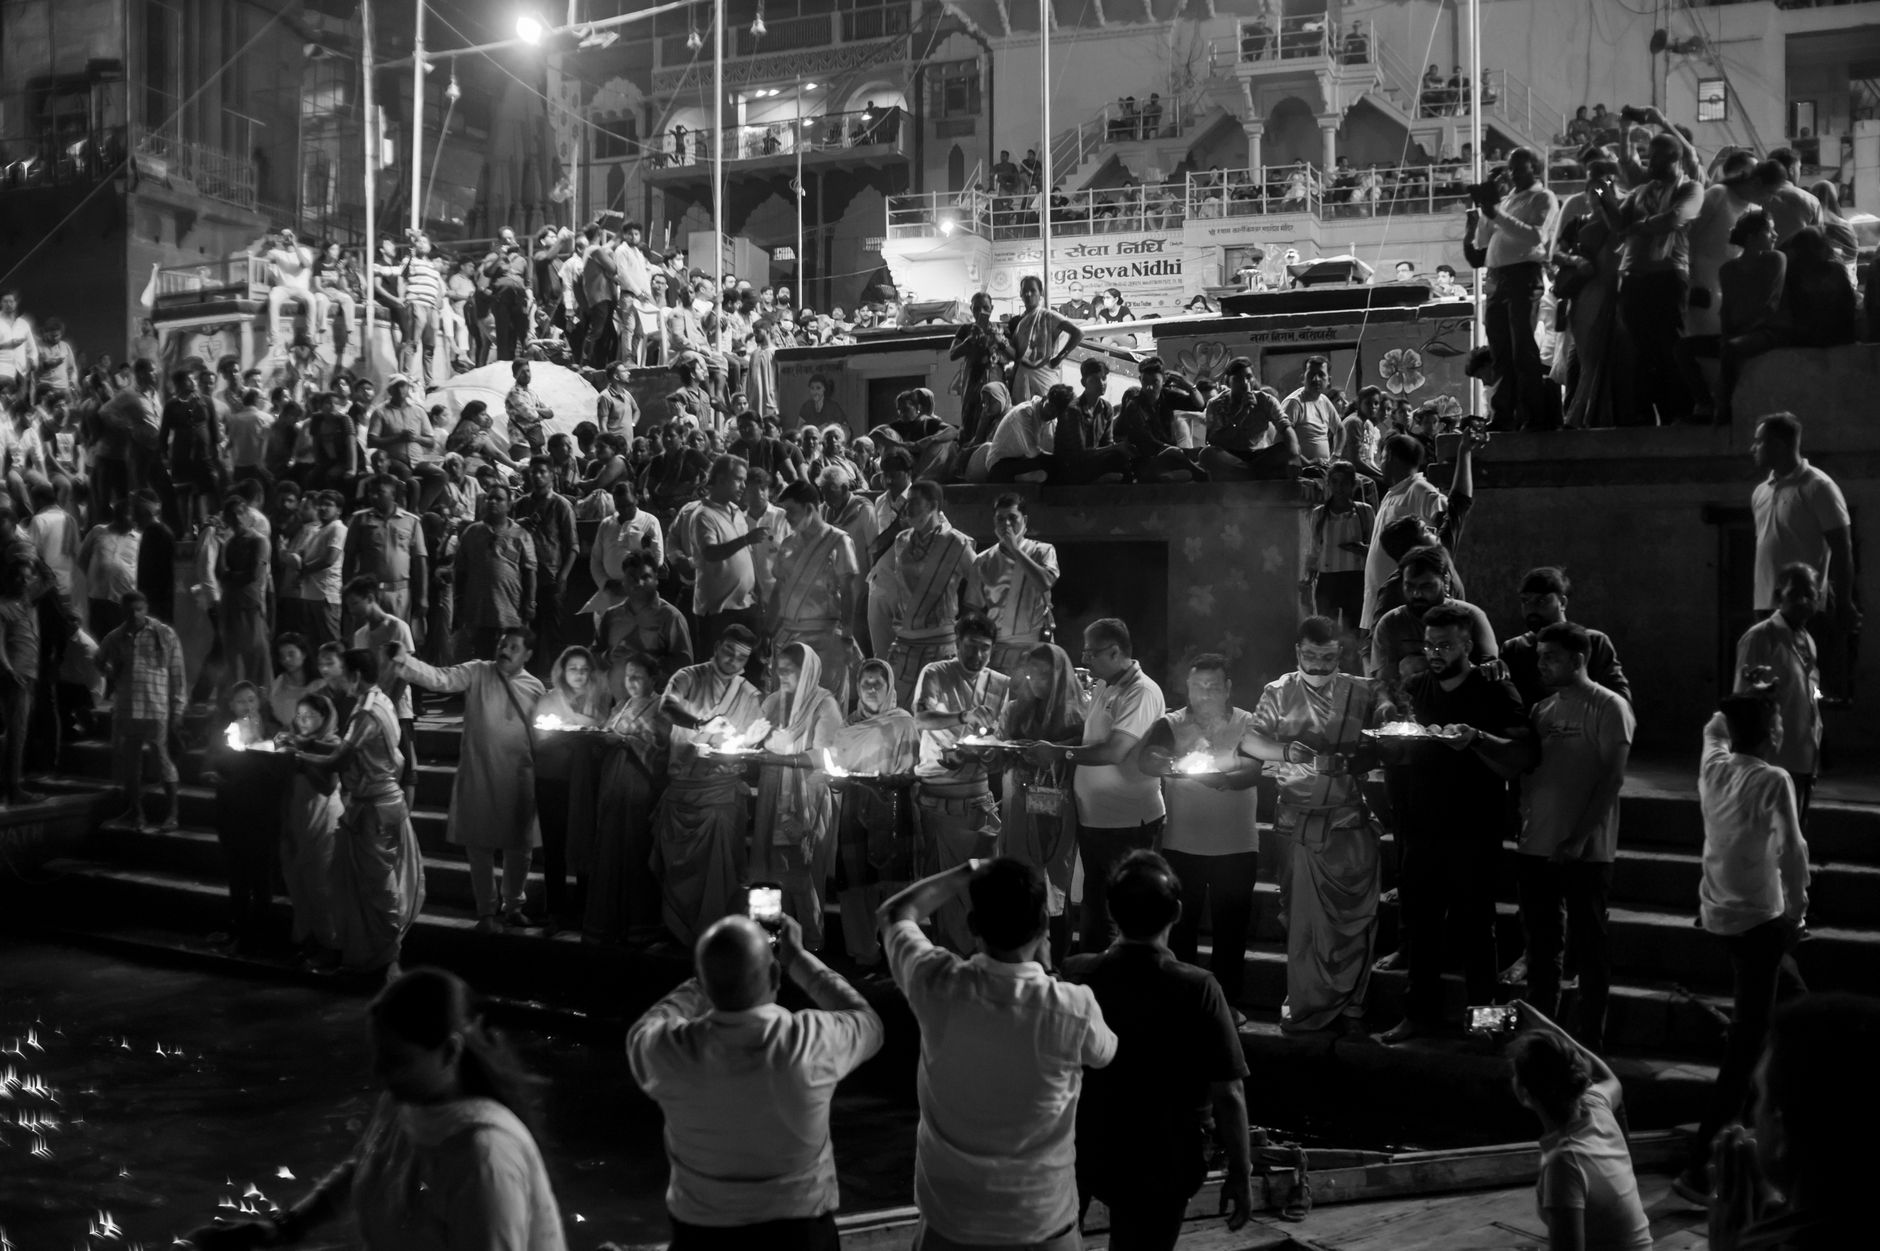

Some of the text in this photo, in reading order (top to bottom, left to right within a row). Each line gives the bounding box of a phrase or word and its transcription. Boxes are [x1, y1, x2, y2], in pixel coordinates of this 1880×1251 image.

[1064, 243, 1110, 258] सेवा
[1115, 238, 1167, 255] निधि
[1082, 263, 1129, 280] Seva
[1131, 258, 1183, 277] Nidhi
